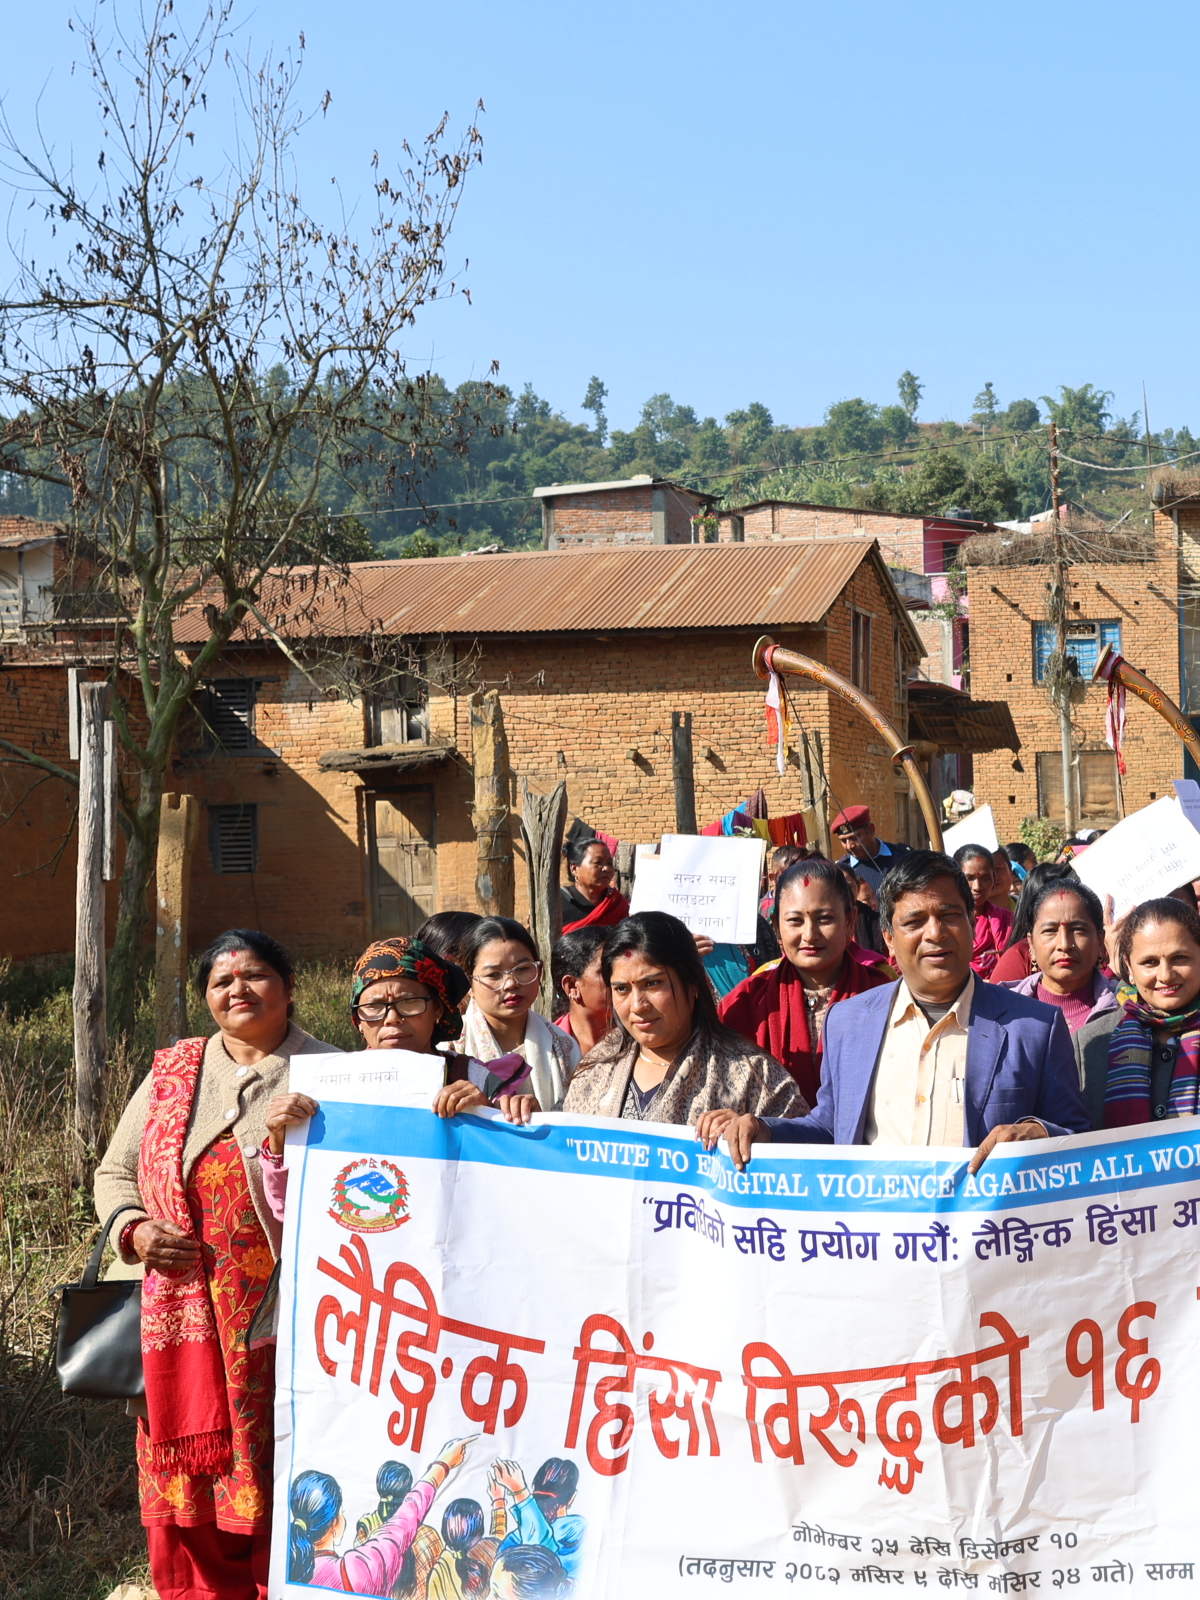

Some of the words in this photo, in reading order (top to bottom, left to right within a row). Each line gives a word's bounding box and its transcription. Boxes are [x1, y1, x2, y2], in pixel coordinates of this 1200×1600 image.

[673, 873, 703, 887] सुन्दर
[358, 1067, 399, 1084] कामको
[657, 1146, 689, 1173] TO
[717, 1165, 809, 1197] DIGITAL
[816, 1174, 955, 1199] VIOLENCE
[962, 1161, 1082, 1199] AGAINST
[1089, 1154, 1143, 1183] ALL
[732, 1217, 787, 1263] सहि
[799, 1221, 880, 1263] प्रयोग
[1085, 1203, 1158, 1246] हिंसा
[564, 1313, 721, 1477] हिंसा
[1065, 1301, 1161, 1424] १६
[791, 1521, 862, 1552] नोभेम्बर
[871, 1538, 899, 1557] २५
[908, 1536, 951, 1557] देखि
[959, 1534, 1040, 1560] डिसेम्बर
[1050, 1532, 1079, 1550] १०
[785, 1562, 841, 1585] २०८२
[849, 1565, 905, 1585] मंसिर
[937, 1567, 979, 1590] देखि
[1051, 1568, 1081, 1590] २४
[1144, 1562, 1195, 1582] सम्म
